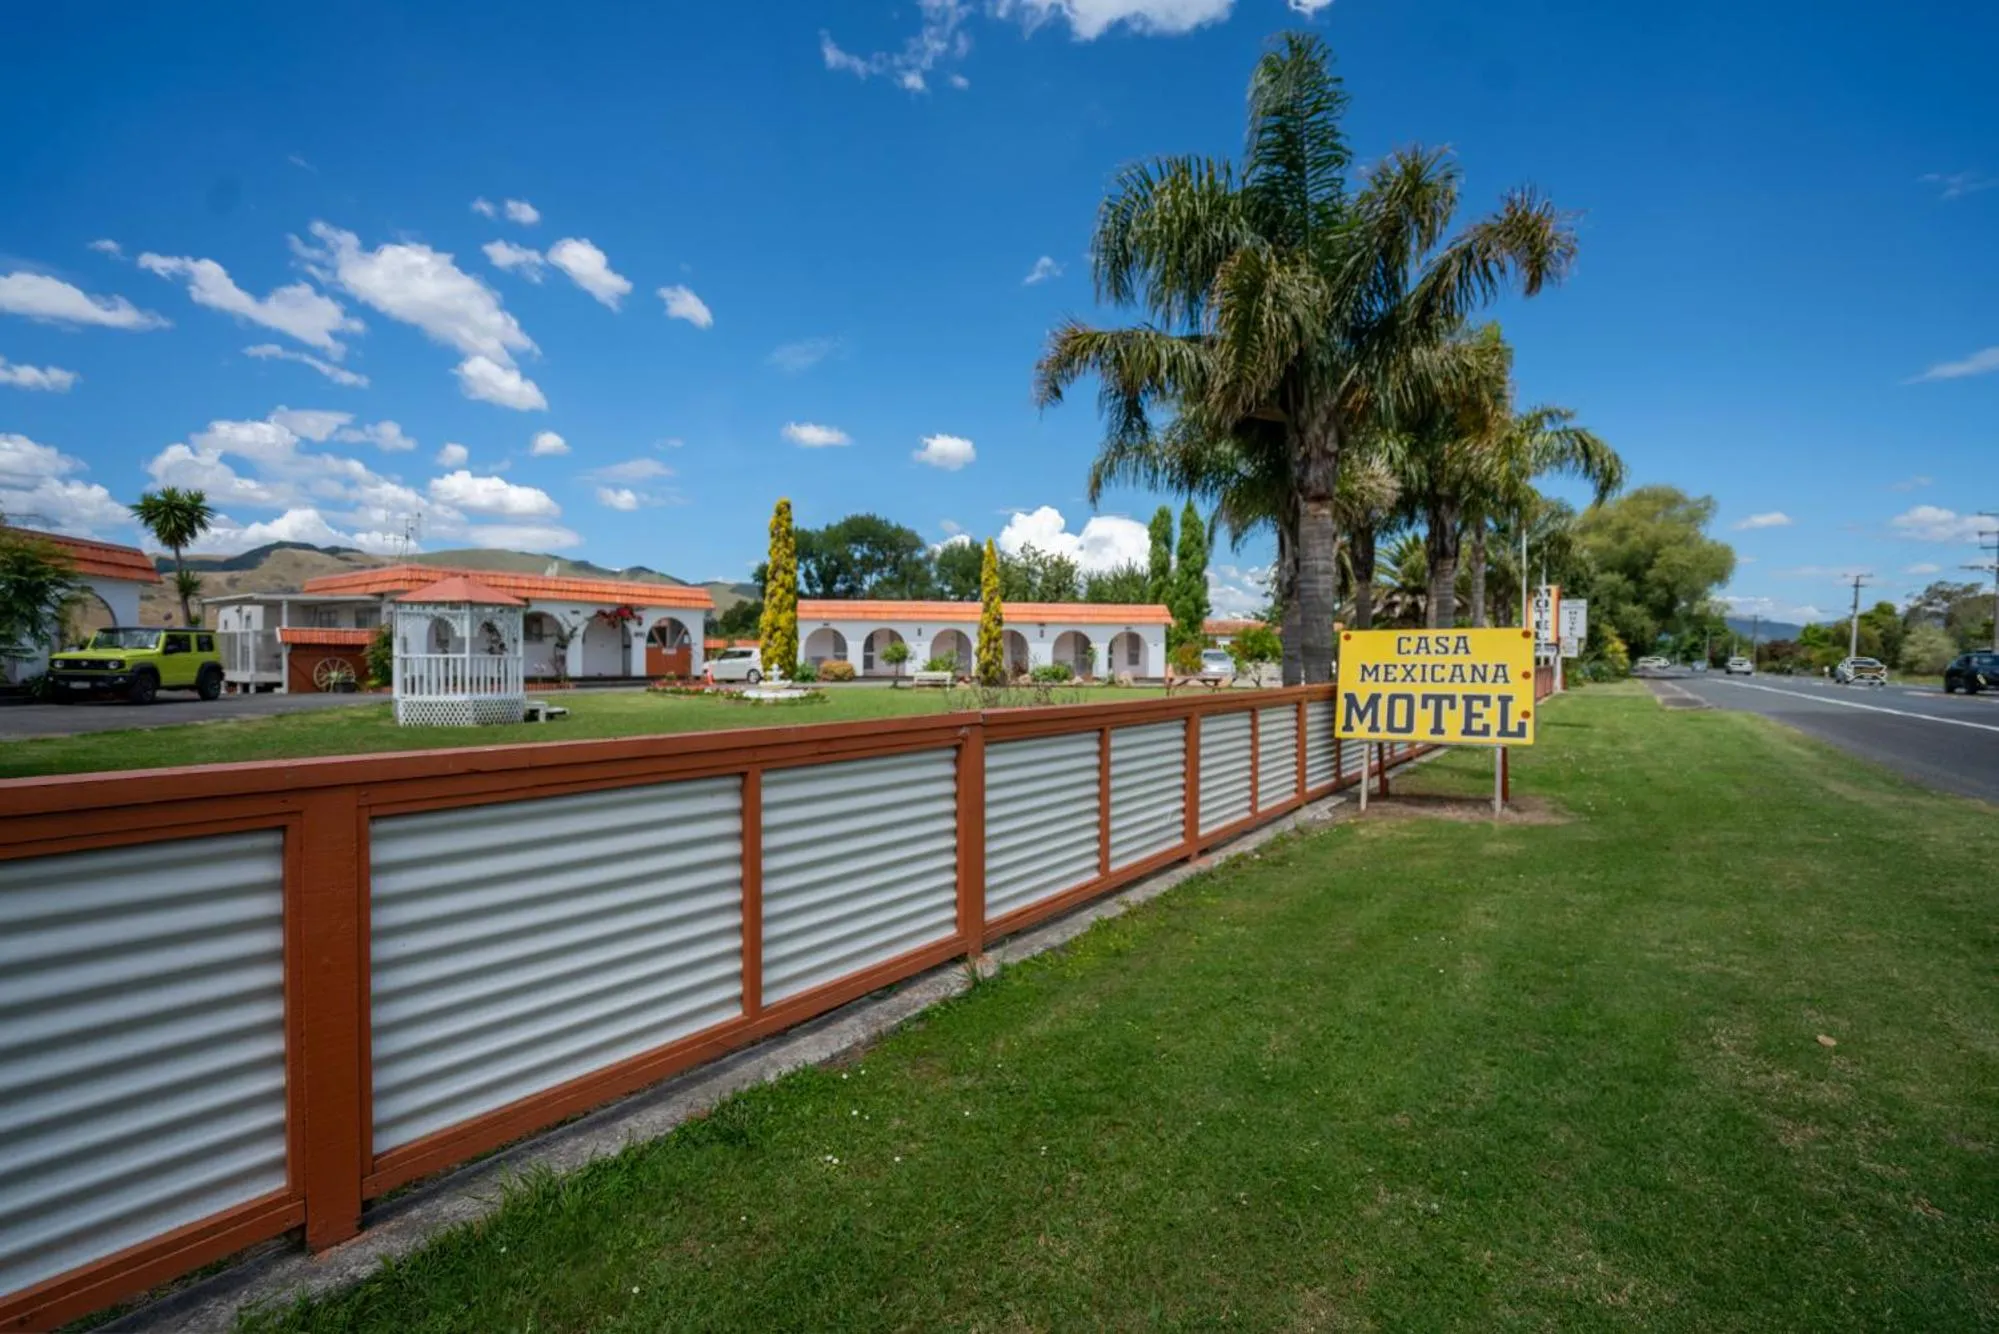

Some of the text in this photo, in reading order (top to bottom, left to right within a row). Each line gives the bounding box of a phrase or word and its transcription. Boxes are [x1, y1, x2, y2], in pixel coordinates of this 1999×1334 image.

[1397, 635, 1471, 655] CASA
[1360, 663, 1510, 684] MEXICANA
[1341, 692, 1527, 738] MOTEL
